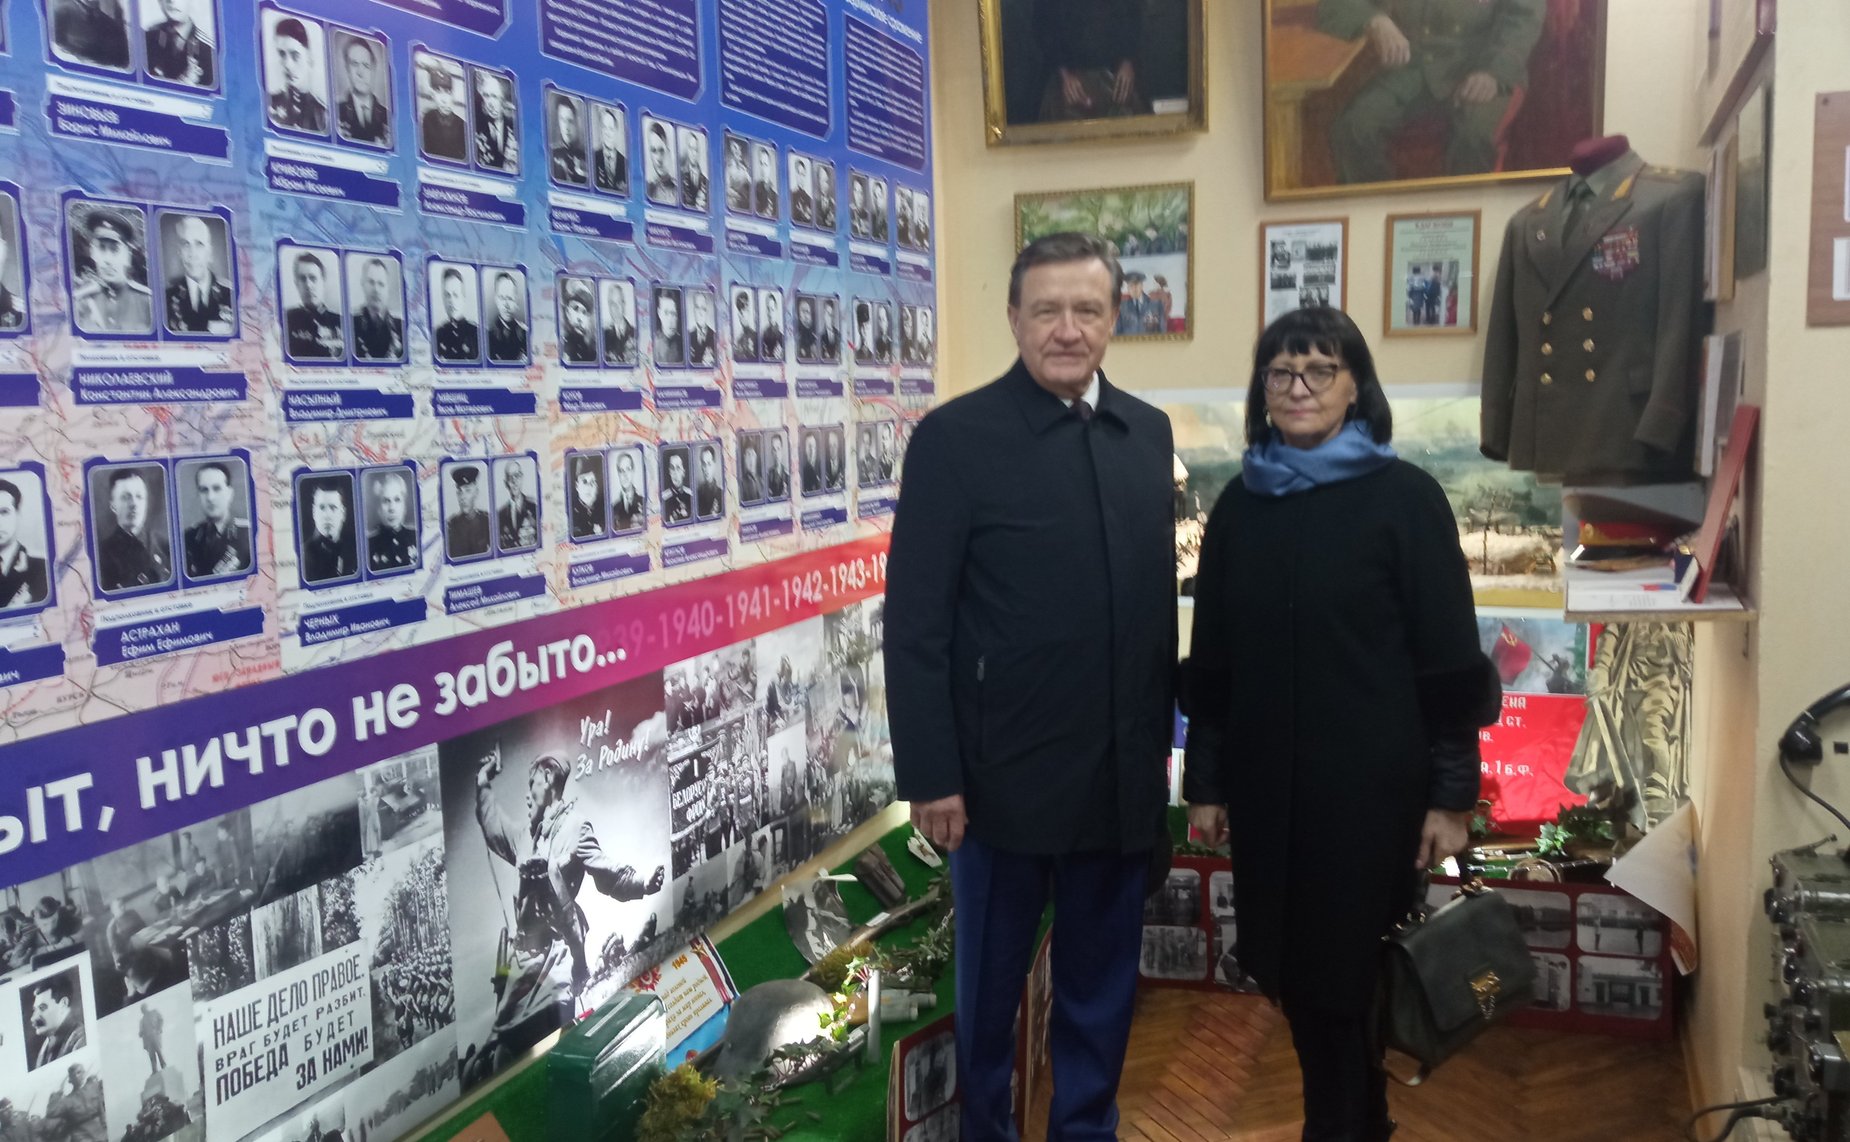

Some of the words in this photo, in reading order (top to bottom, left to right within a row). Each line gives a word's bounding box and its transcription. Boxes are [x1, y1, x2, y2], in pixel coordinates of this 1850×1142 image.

[78, 370, 175, 386] НИКОЛАЕВСКИЙ
[80, 388, 151, 401] Константин
[152, 386, 240, 400] Александрович
[121, 621, 181, 644] АСТРАХАН
[304, 613, 340, 630] ЧЕРНЫХ
[305, 625, 350, 643] Владимир
[350, 617, 391, 634] Иванович
[121, 643, 157, 659] Ефим
[157, 631, 214, 651] Ефимович
[136, 707, 337, 810] ничто
[351, 683, 421, 742] не
[434, 633, 627, 716] забыто...
[580, 709, 612, 748] Ура!
[575, 753, 593, 782] За
[598, 731, 650, 771] Родину!
[671, 953, 689, 971] 1945
[213, 998, 263, 1050] НАШЕ
[267, 979, 309, 1028] ДЕЛО
[312, 954, 365, 1002] ПРАВОЕ.
[215, 1041, 256, 1072] ВРАГ
[263, 1014, 308, 1048] БУДЕТ
[316, 986, 366, 1020] РАЗБИТ.
[216, 1042, 289, 1106] ПОБЕДА
[304, 1010, 355, 1052] БУДЕТ
[296, 1056, 317, 1090] ЗА
[323, 1026, 369, 1075] НАМИ!
